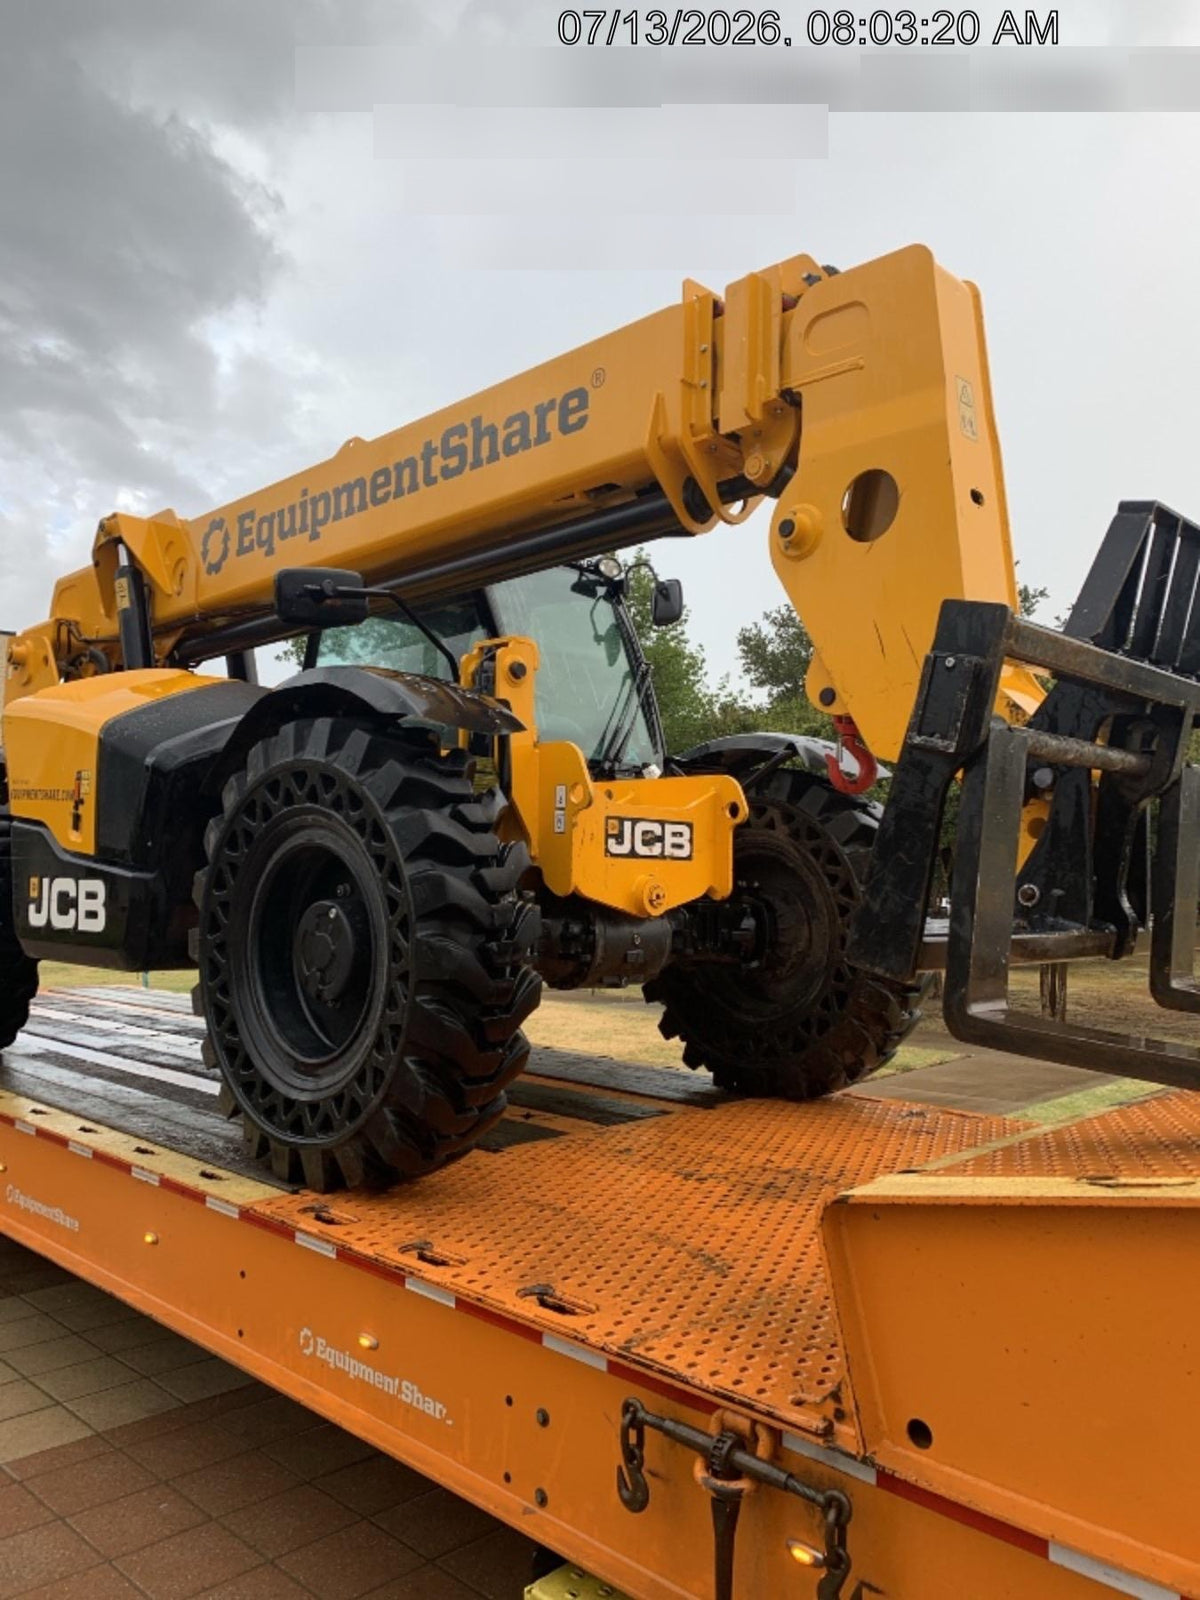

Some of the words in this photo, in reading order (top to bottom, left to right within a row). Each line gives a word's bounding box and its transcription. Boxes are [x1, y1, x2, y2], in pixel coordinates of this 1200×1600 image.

[606, 819, 692, 858] JCB
[27, 877, 106, 933] JCB
[315, 1337, 454, 1426] EquipmentShar
